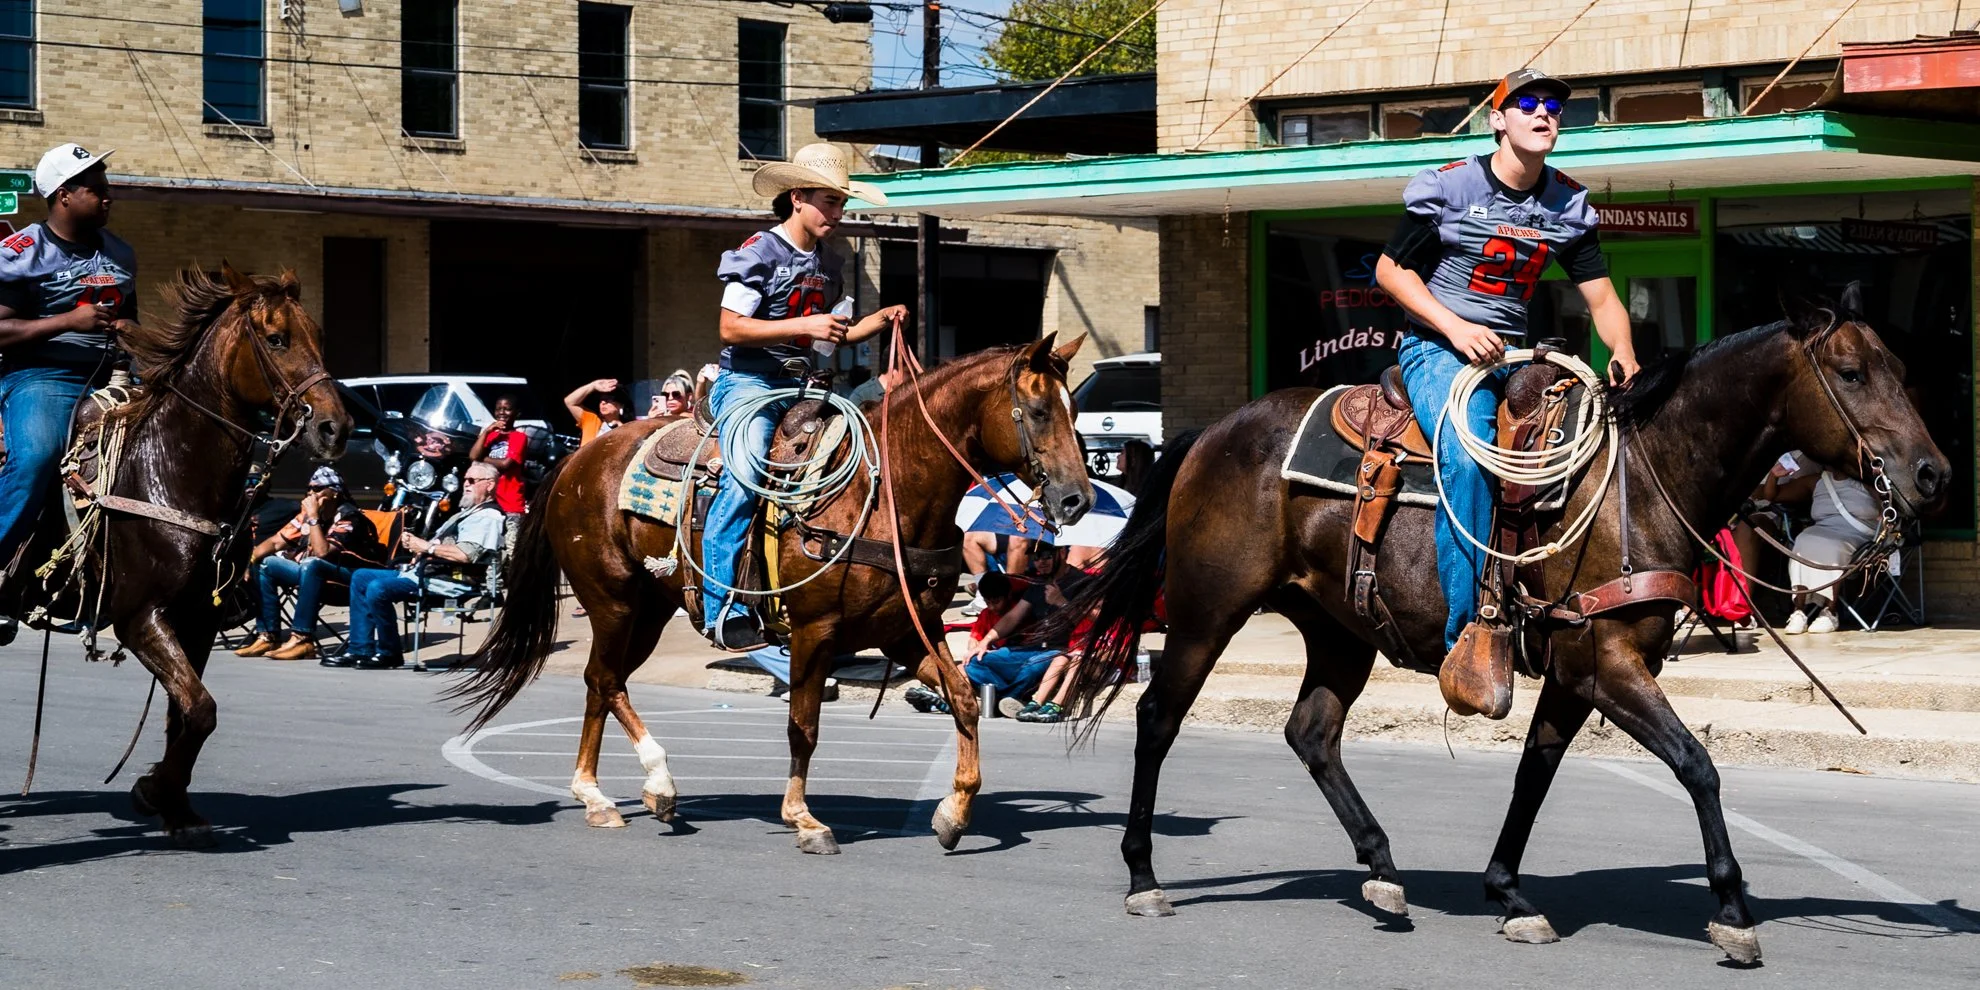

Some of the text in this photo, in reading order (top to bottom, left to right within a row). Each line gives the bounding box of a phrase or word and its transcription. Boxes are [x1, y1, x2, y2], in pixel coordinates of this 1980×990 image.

[10, 178, 25, 188] 500
[1599, 209, 1688, 228] INDA'S NAILS
[1497, 225, 1543, 239] APACHES
[1468, 237, 1549, 301] 24
[80, 275, 116, 285] APACHES
[1299, 326, 1385, 373] Linda's
